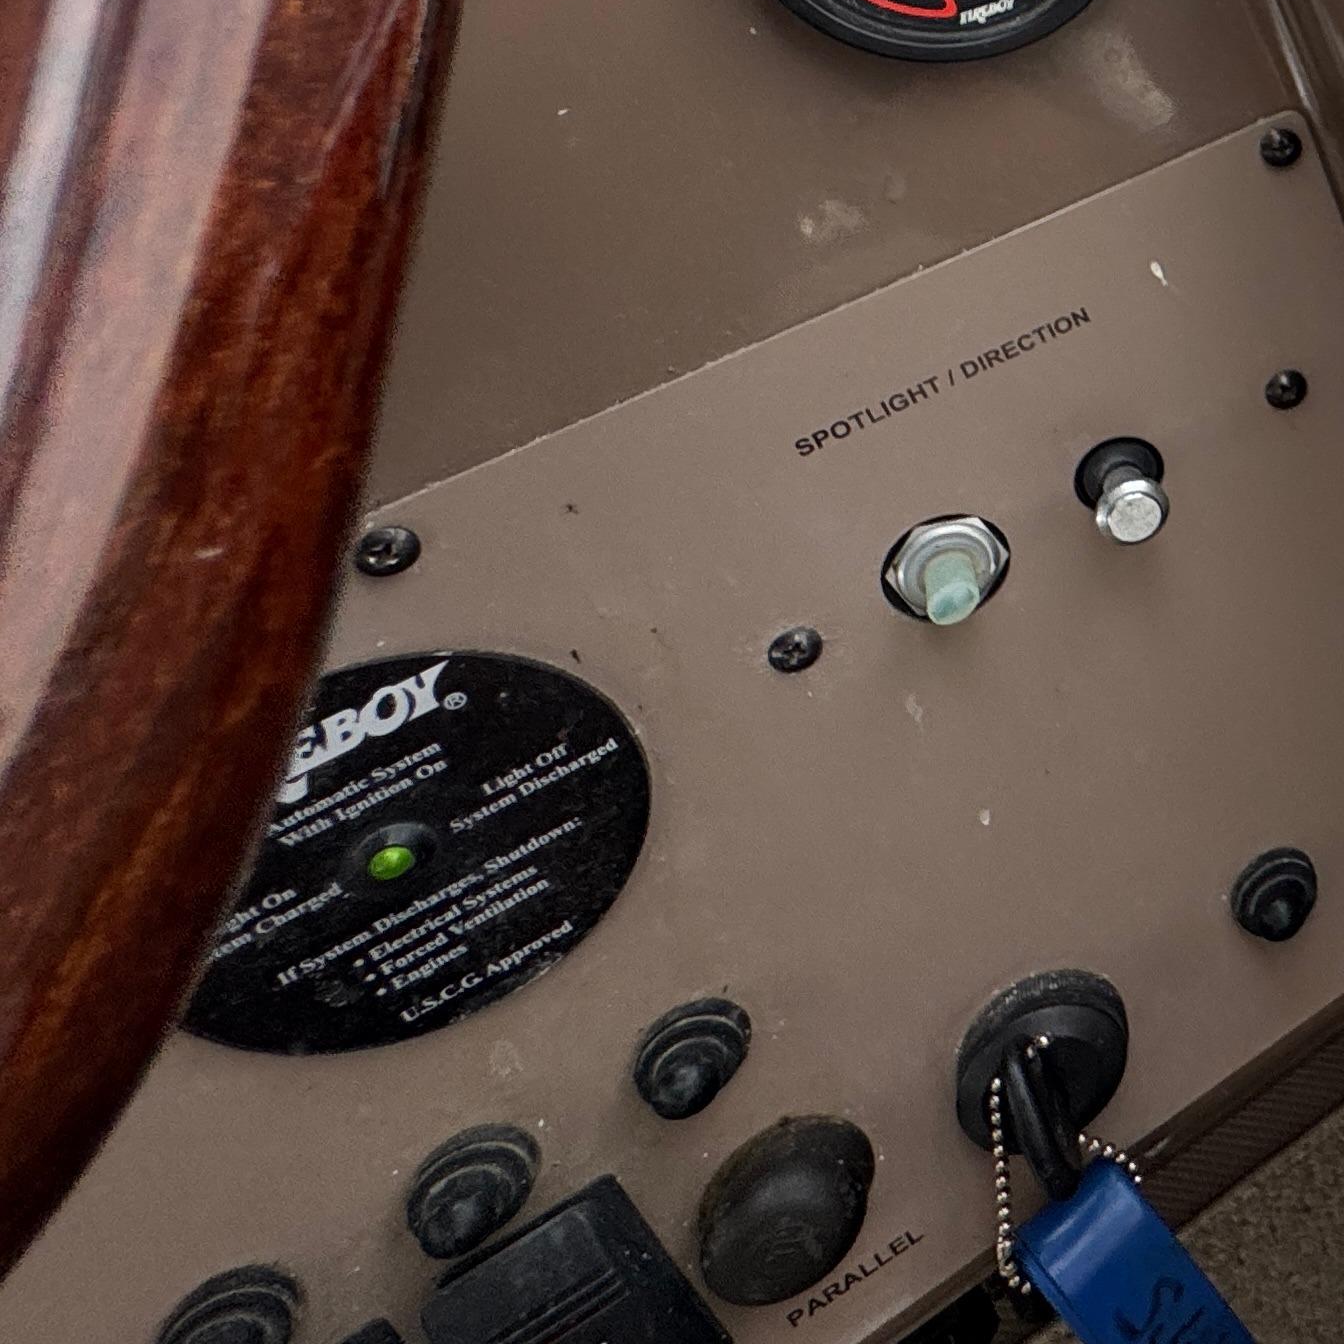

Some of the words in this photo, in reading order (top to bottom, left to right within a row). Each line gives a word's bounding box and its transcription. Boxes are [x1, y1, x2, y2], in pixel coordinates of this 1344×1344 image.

[795, 375, 941, 458] SPOTLIGHT
[960, 307, 1092, 380] DIRECTION
[270, 777, 371, 837] Automatic
[370, 742, 442, 784] System
[277, 816, 335, 847] With
[335, 777, 415, 822] Ignition
[416, 759, 449, 781] On
[450, 792, 518, 834] System
[518, 736, 619, 797] Discharged
[481, 763, 535, 796] Light
[534, 742, 568, 768] Off
[255, 881, 343, 934] Charged
[262, 888, 297, 910] On
[277, 966, 299, 987] If
[299, 931, 372, 975] System
[483, 816, 584, 876] Shutdown:
[368, 903, 462, 961] Electrical
[461, 864, 538, 912] Systems
[379, 931, 450, 976] Forced
[448, 877, 550, 936] Ventilation
[391, 943, 470, 991] Engines
[485, 917, 575, 979] Approved
[785, 1228, 925, 1328] PARALLEL
